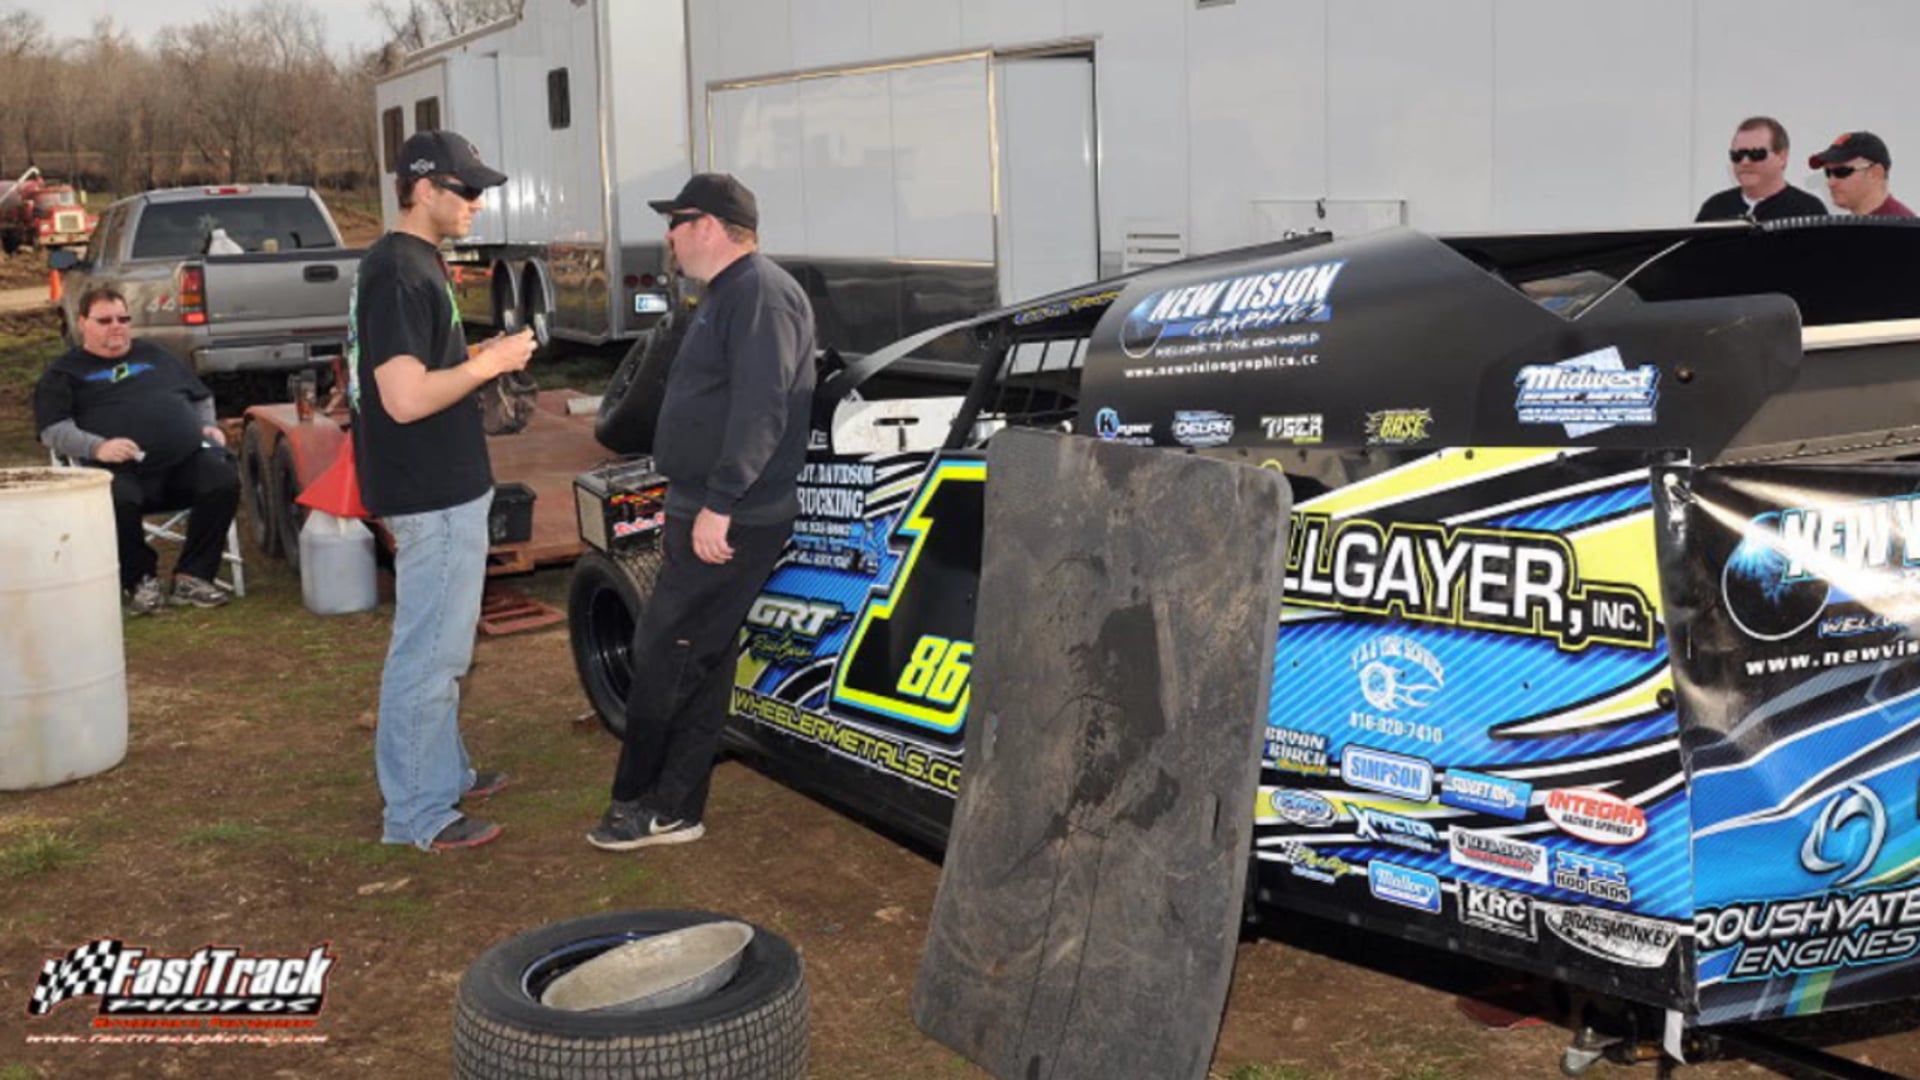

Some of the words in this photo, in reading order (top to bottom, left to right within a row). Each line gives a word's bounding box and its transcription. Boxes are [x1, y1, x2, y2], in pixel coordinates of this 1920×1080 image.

[1150, 281, 1228, 321] NEW
[1219, 262, 1344, 313] VISION
[1516, 365, 1655, 391] Midwest
[1284, 527, 1584, 636] LGAYER,
[1592, 608, 1643, 633] INC.
[746, 596, 838, 637] GRT
[896, 636, 974, 705] 86
[1350, 755, 1424, 792] SIMPSON
[1548, 789, 1644, 828] INTEGRA
[1467, 887, 1527, 923] KRC
[1733, 927, 1917, 975] ENGINES
